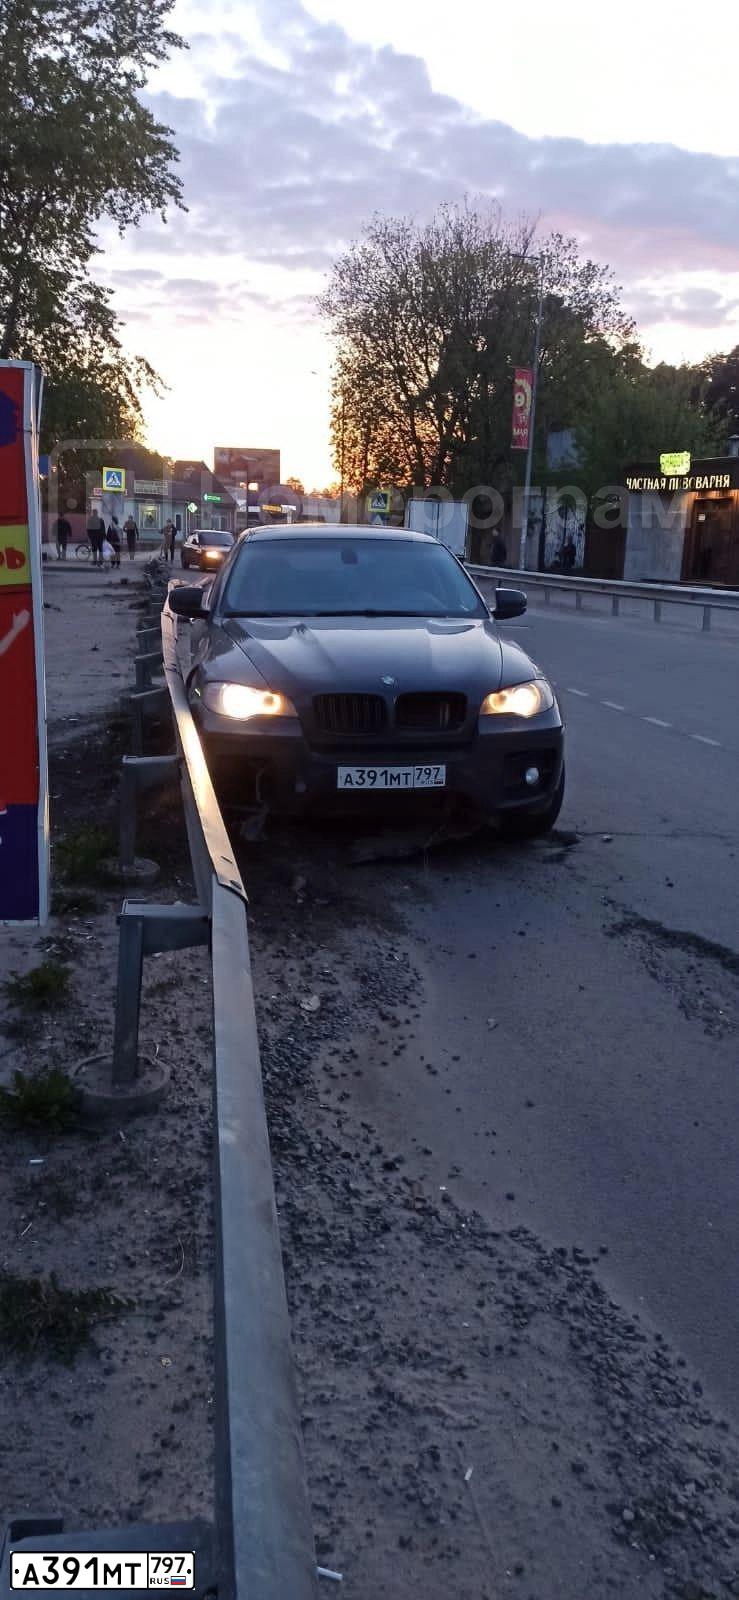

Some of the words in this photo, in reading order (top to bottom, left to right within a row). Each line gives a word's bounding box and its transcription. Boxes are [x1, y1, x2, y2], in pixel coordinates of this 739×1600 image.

[514, 391, 526, 408] 9
[626, 477, 666, 490] ЧАСТНАЯ
[343, 769, 412, 786] А391МТ
[415, 767, 441, 781] 797
